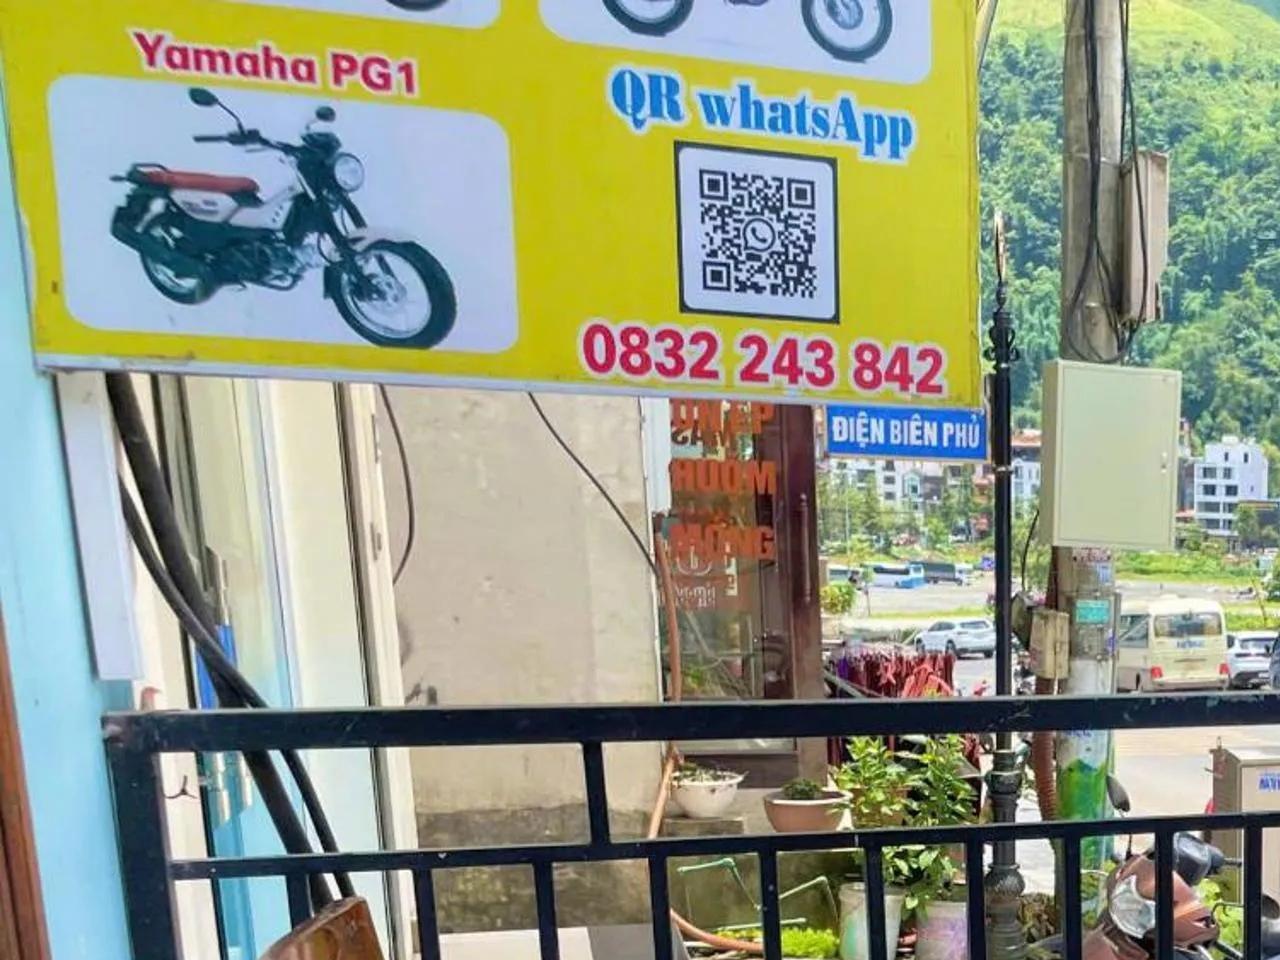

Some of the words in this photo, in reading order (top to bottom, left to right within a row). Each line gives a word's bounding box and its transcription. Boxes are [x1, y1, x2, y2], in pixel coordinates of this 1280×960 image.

[134, 31, 317, 83] Yamaha
[330, 52, 415, 93] PG1
[610, 69, 683, 129] QR
[697, 84, 913, 159] whatsApp
[582, 324, 719, 380] 0832
[739, 335, 835, 387] 243
[853, 343, 943, 394] 842
[832, 411, 884, 448] ĐIỆN
[890, 413, 937, 447] BIÊN
